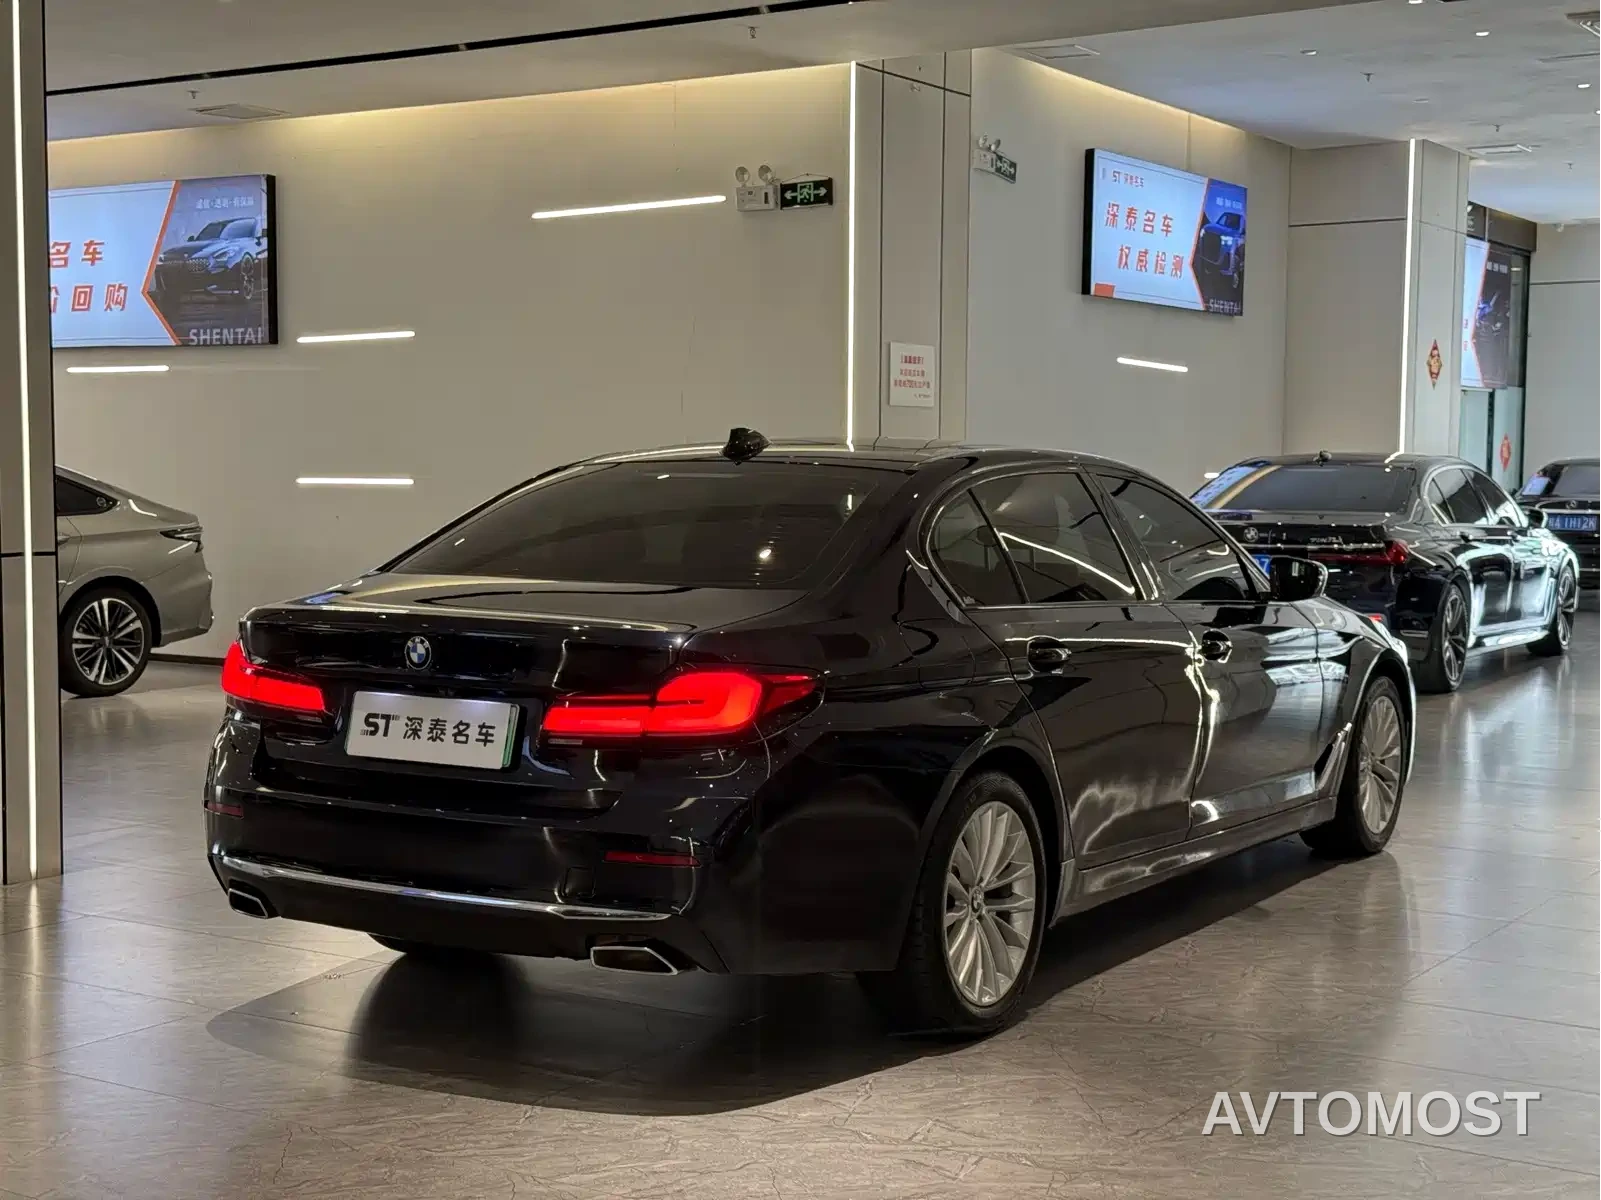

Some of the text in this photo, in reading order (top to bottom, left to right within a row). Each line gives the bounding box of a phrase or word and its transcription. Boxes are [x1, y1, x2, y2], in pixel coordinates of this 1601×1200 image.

[1104, 202, 1174, 238] 深泰名车
[1117, 244, 1184, 280] 权威检测
[189, 326, 263, 345] SHENTAI
[363, 712, 496, 747] ST 深泰名车
